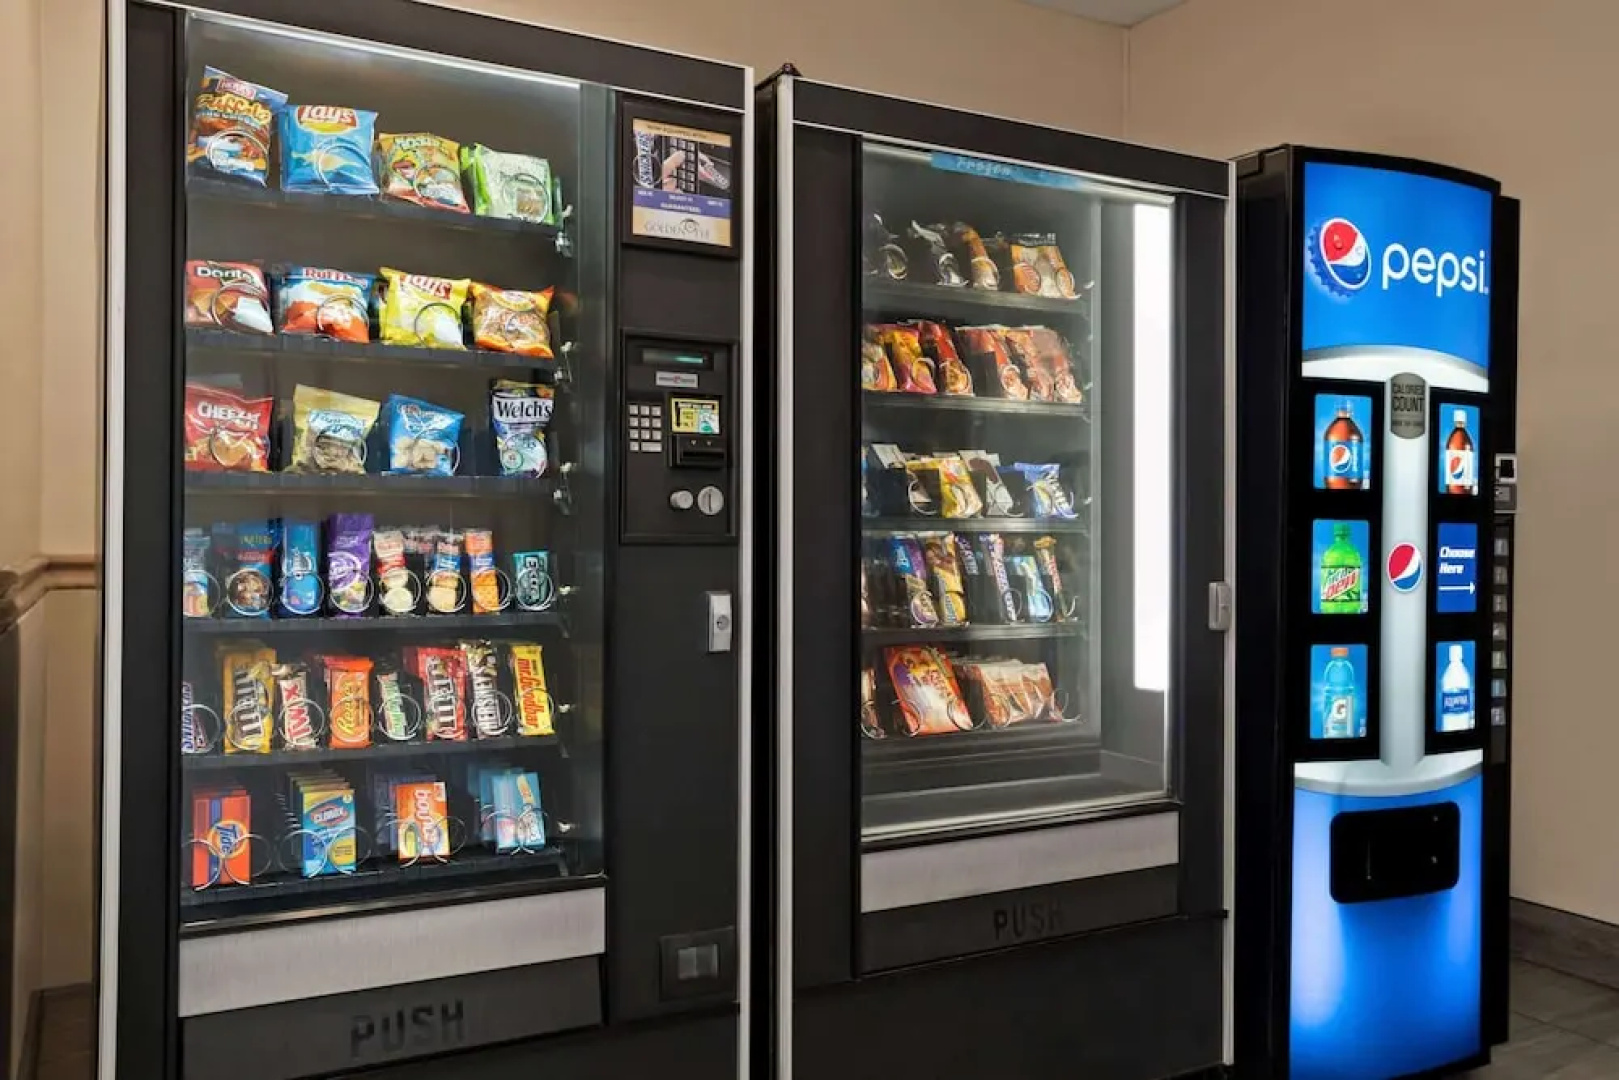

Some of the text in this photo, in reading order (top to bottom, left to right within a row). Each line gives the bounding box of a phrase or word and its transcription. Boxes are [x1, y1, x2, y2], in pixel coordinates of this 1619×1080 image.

[1382, 242, 1486, 298] pepsi
[496, 400, 552, 419] Welch's
[216, 825, 239, 855] Tide
[992, 901, 1062, 941] PUSH
[350, 999, 465, 1059] PUSH
